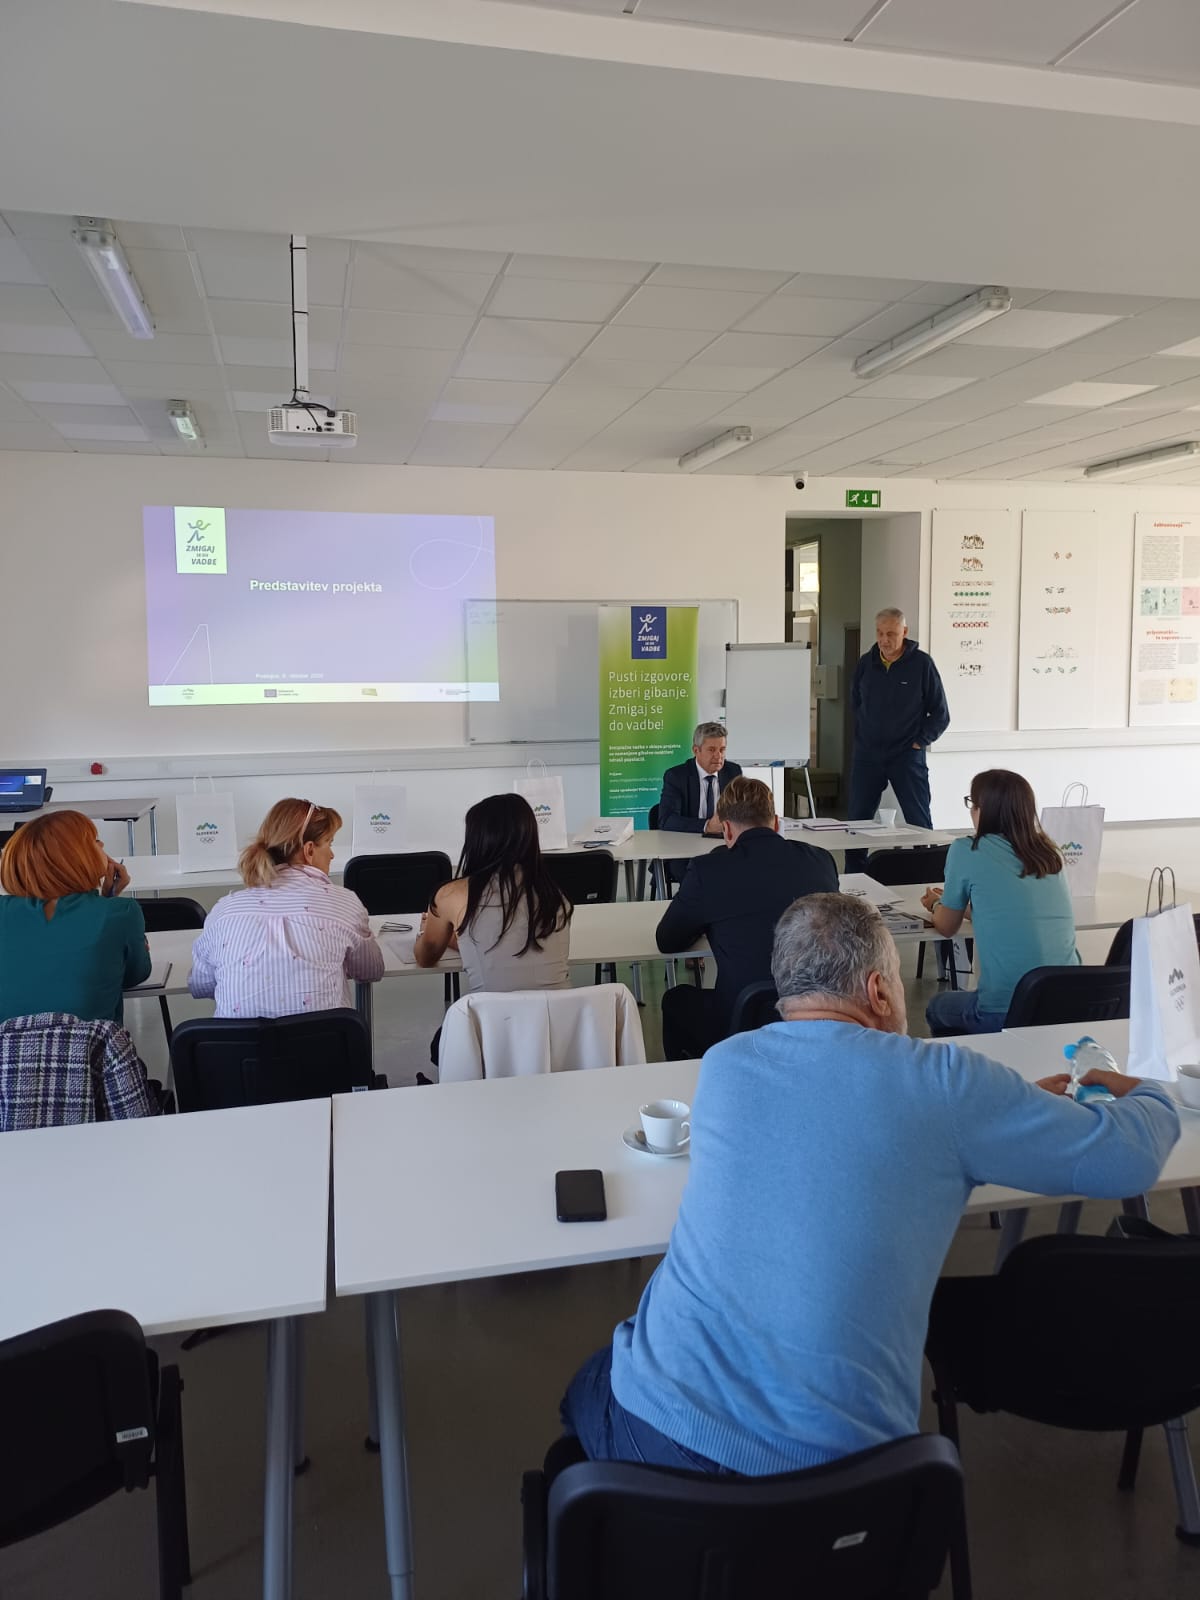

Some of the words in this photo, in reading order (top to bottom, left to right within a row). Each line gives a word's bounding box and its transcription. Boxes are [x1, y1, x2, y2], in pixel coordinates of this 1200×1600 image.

[186, 545, 215, 553] ZMIGAJ
[250, 580, 328, 592] Predstavitev
[332, 581, 383, 594] projekta
[608, 671, 637, 682] Pusti
[640, 672, 693, 684] izgovore,
[609, 687, 640, 698] izberi
[644, 686, 689, 700] gibanje.
[608, 704, 648, 717] Zmigaj
[650, 705, 663, 714] se
[609, 720, 624, 731] do
[626, 719, 664, 731] vadbe!
